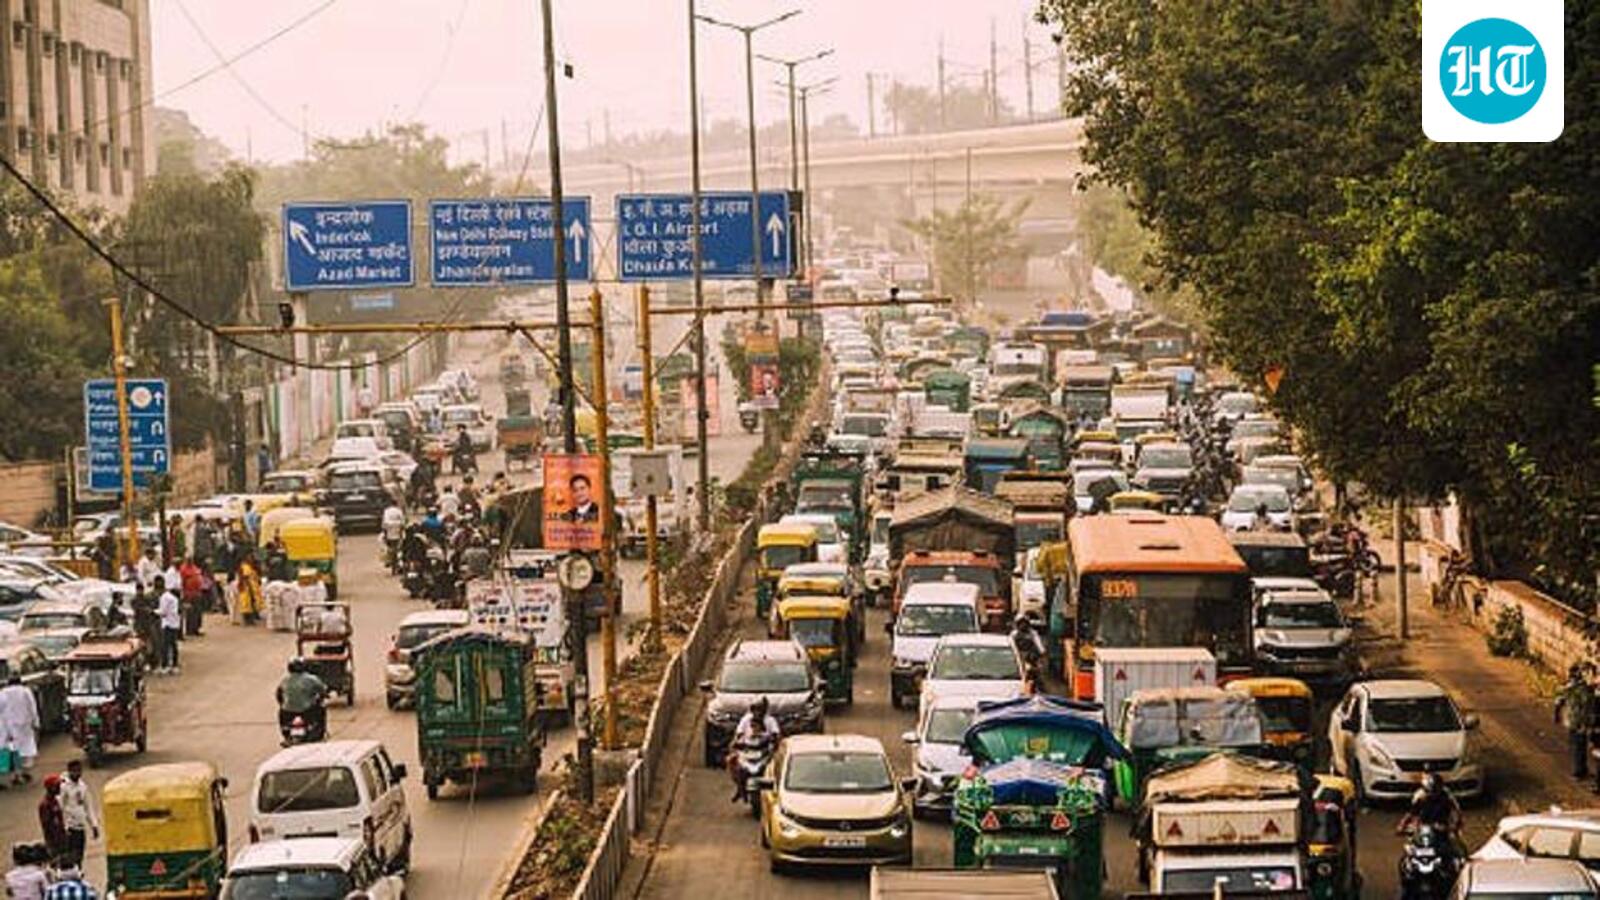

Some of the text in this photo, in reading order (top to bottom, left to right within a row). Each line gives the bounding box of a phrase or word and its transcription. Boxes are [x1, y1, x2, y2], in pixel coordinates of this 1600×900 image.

[315, 229, 372, 244] Inderlok
[318, 265, 401, 281] Azad Market
[624, 259, 675, 273] Dhaula
